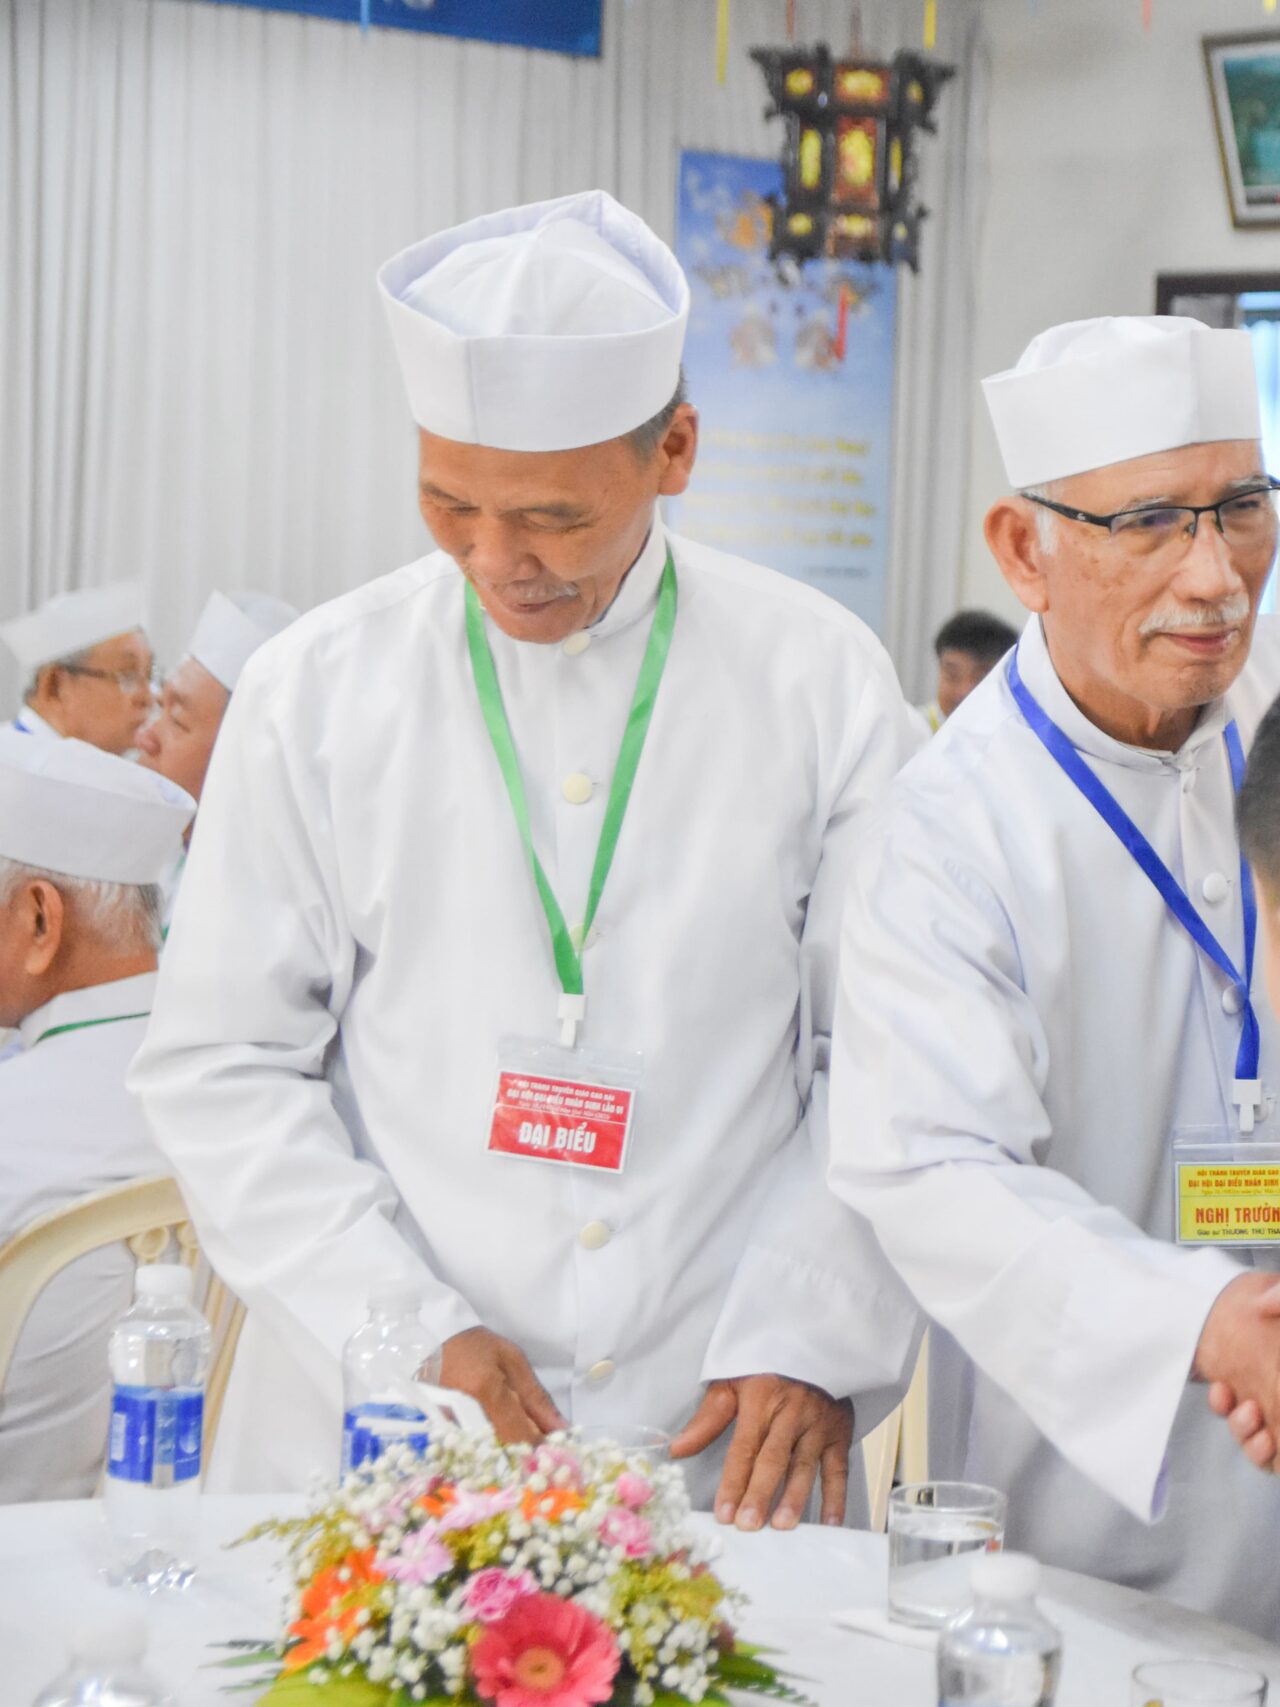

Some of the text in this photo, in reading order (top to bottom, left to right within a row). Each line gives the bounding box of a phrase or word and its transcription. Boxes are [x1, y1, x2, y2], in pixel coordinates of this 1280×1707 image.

[518, 1122, 597, 1153] ĐẠI BIỂU
[1195, 1207, 1230, 1227] NGHỊ
